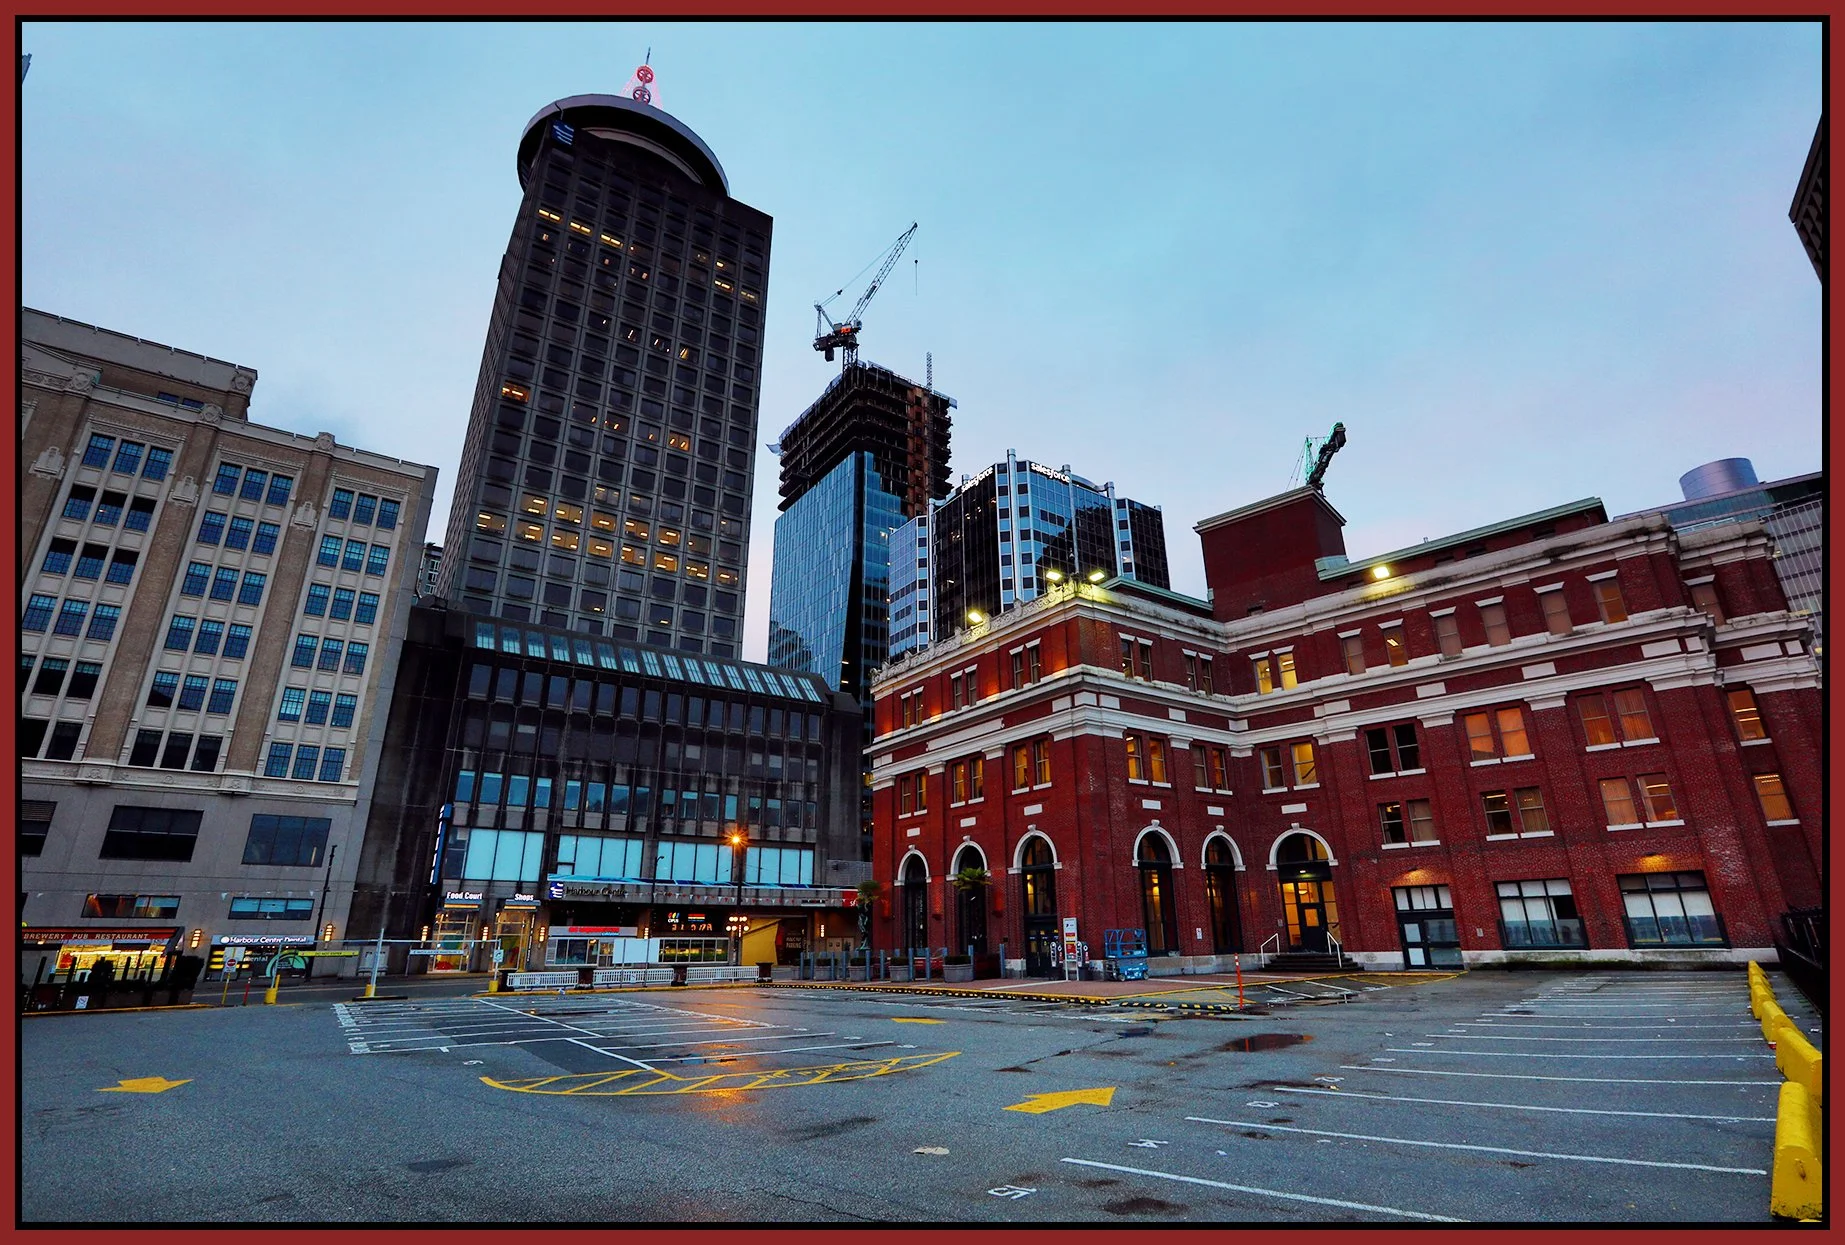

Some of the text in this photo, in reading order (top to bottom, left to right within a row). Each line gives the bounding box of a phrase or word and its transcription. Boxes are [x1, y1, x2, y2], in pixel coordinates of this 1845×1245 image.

[1031, 463, 1070, 483] salesforce
[961, 467, 993, 493] salesforce
[447, 892, 483, 900] Food Court
[566, 886, 600, 896] Harbour
[514, 893, 534, 901] Shops
